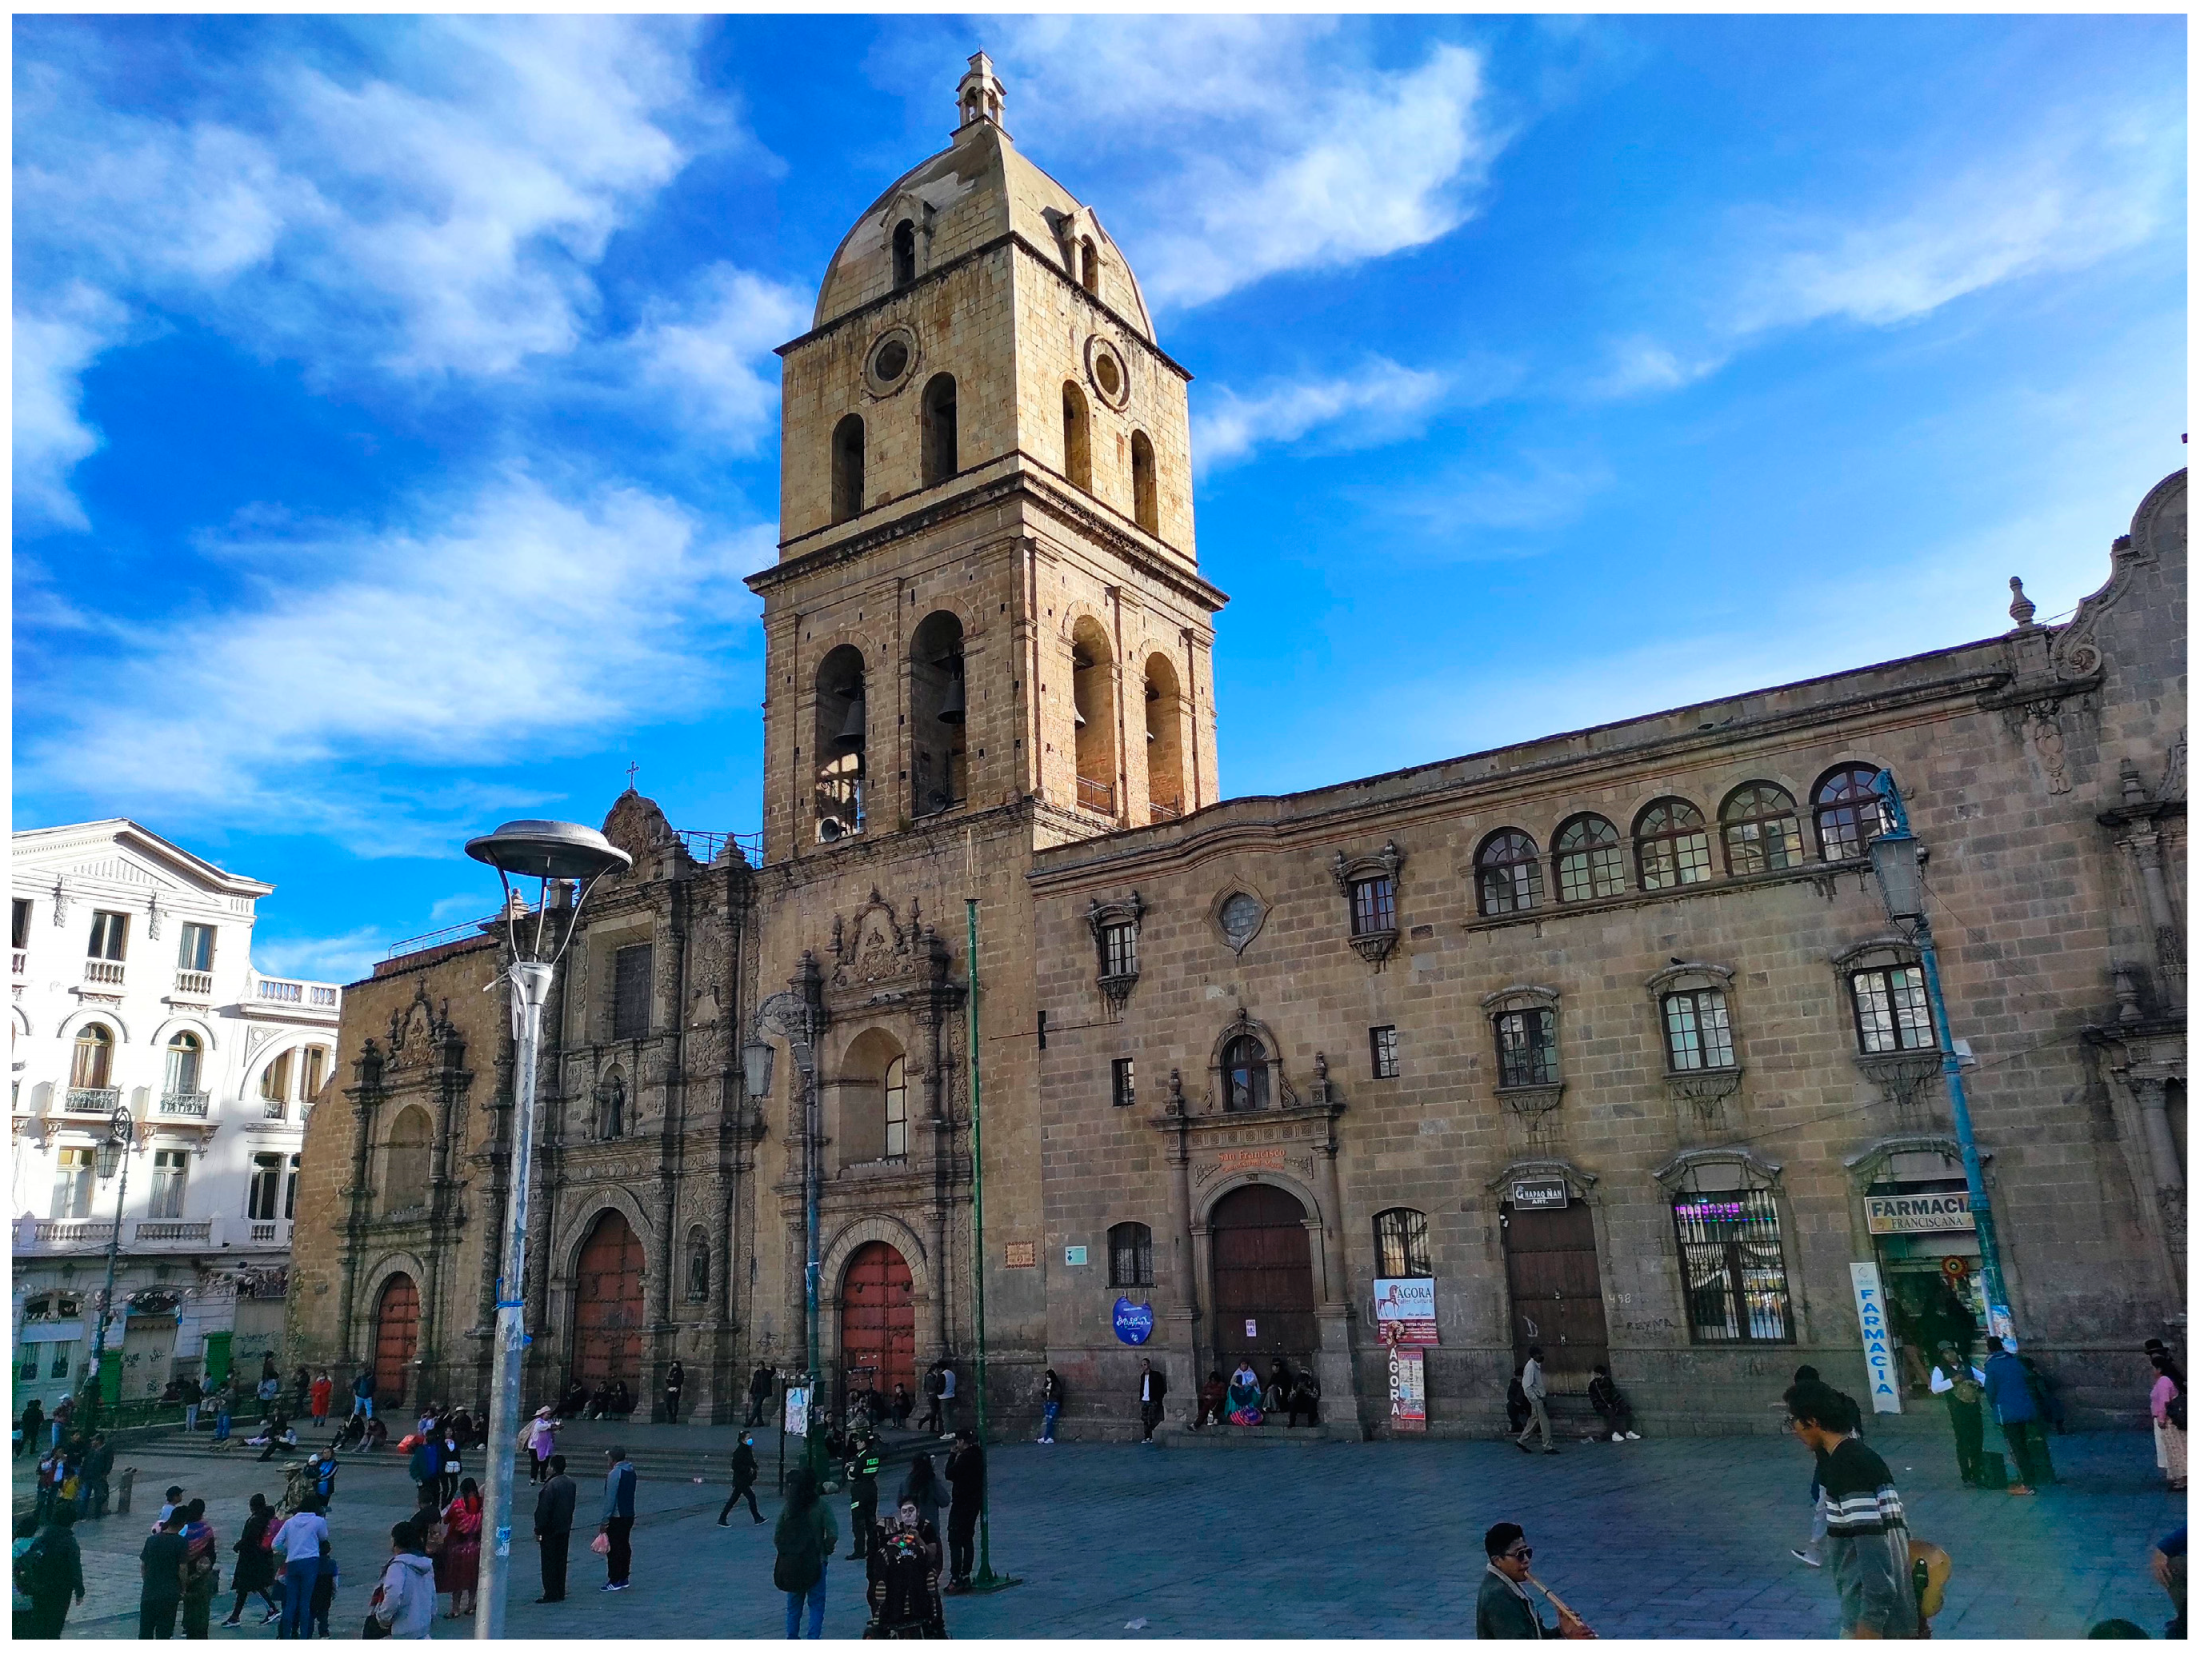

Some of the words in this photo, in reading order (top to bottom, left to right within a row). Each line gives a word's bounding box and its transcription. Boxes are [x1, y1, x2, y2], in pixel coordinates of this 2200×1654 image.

[1218, 1152, 1236, 1161] San
[1240, 1149, 1286, 1160] Francisco
[1871, 1198, 1972, 1217] FARMACI
[1891, 1216, 1963, 1229] FRANCISCANA
[1397, 1285, 1432, 1299] ÁGORA
[1860, 1289, 1894, 1395] FARMACIA
[1389, 1345, 1400, 1416] ÁGORA
